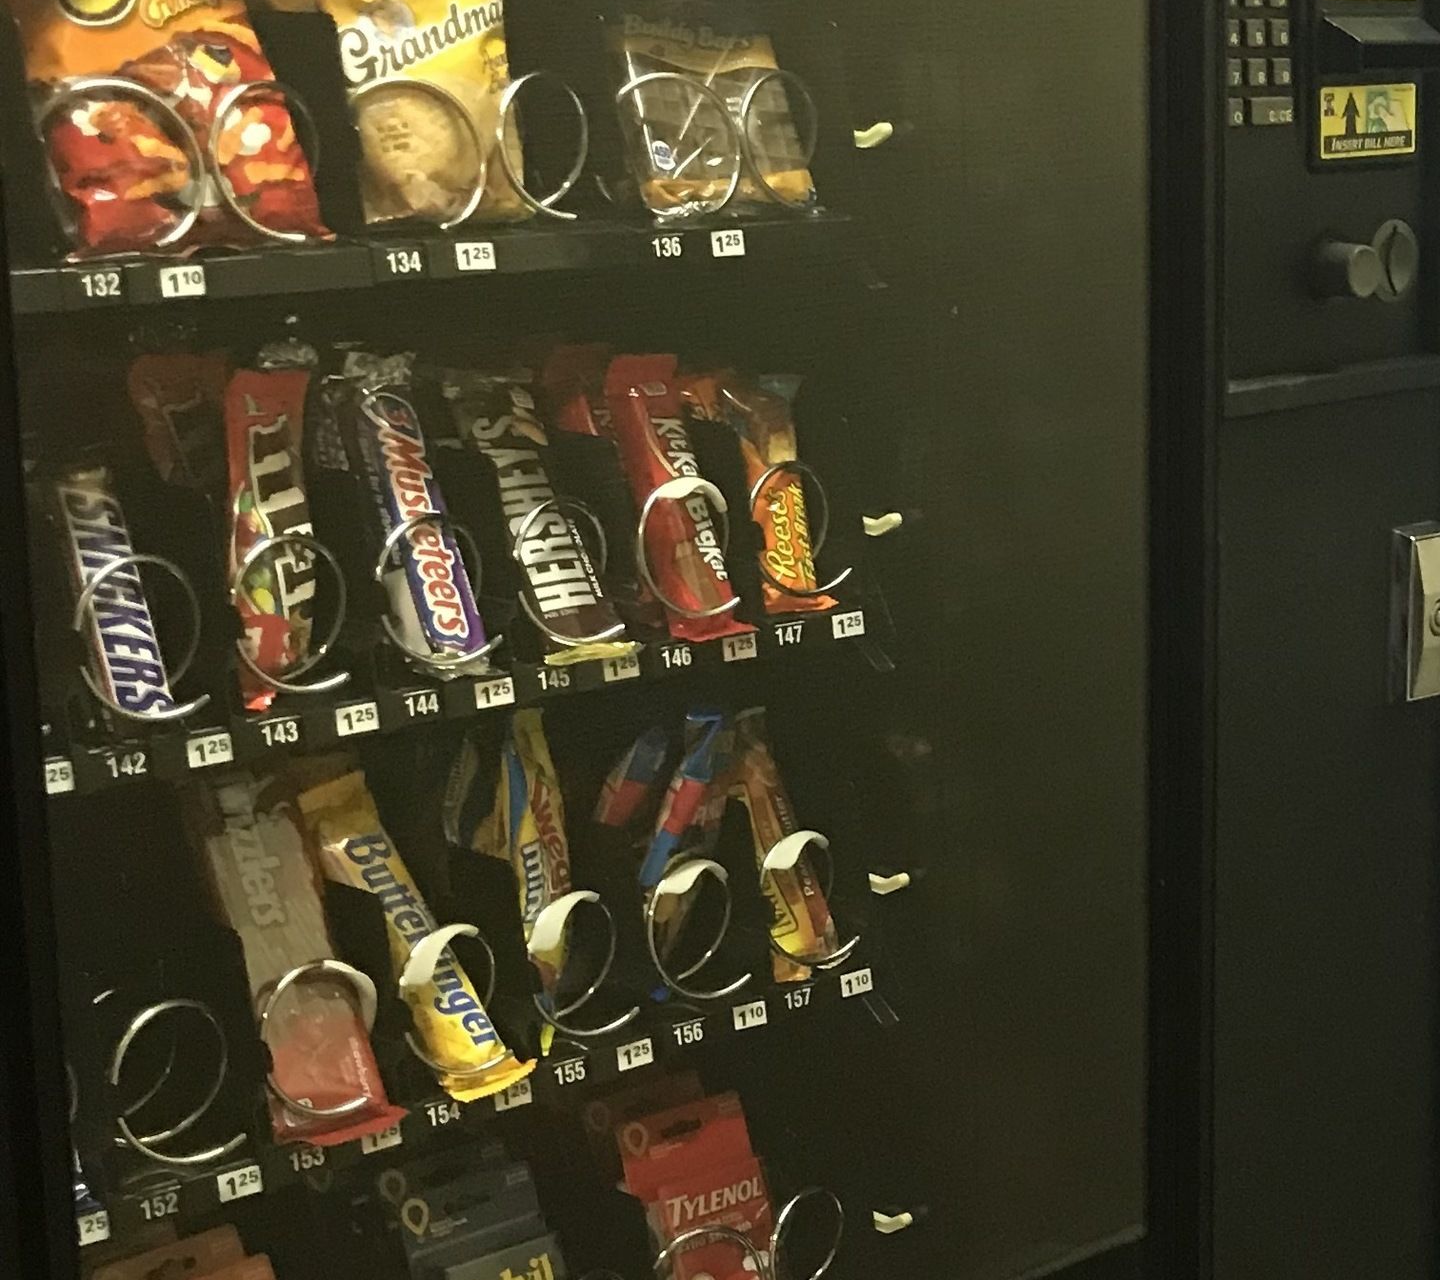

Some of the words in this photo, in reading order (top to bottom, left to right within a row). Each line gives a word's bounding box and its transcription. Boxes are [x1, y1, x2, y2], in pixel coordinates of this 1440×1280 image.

[651, 236, 682, 258] 136
[386, 250, 423, 274] 134
[81, 272, 121, 298] 132
[62, 488, 175, 718] SNICKERS
[775, 624, 803, 646] 147
[661, 646, 693, 669] 146
[537, 670, 571, 691] 145
[404, 692, 440, 717] 144
[261, 720, 299, 746] 143
[106, 751, 147, 778] 142
[784, 986, 813, 1011] 157
[673, 1021, 704, 1046] 156
[554, 1060, 587, 1086] 155
[427, 1101, 462, 1127] 154
[288, 1146, 326, 1172] 153
[140, 1192, 179, 1221] 152
[666, 1176, 764, 1228] TYLENOL
